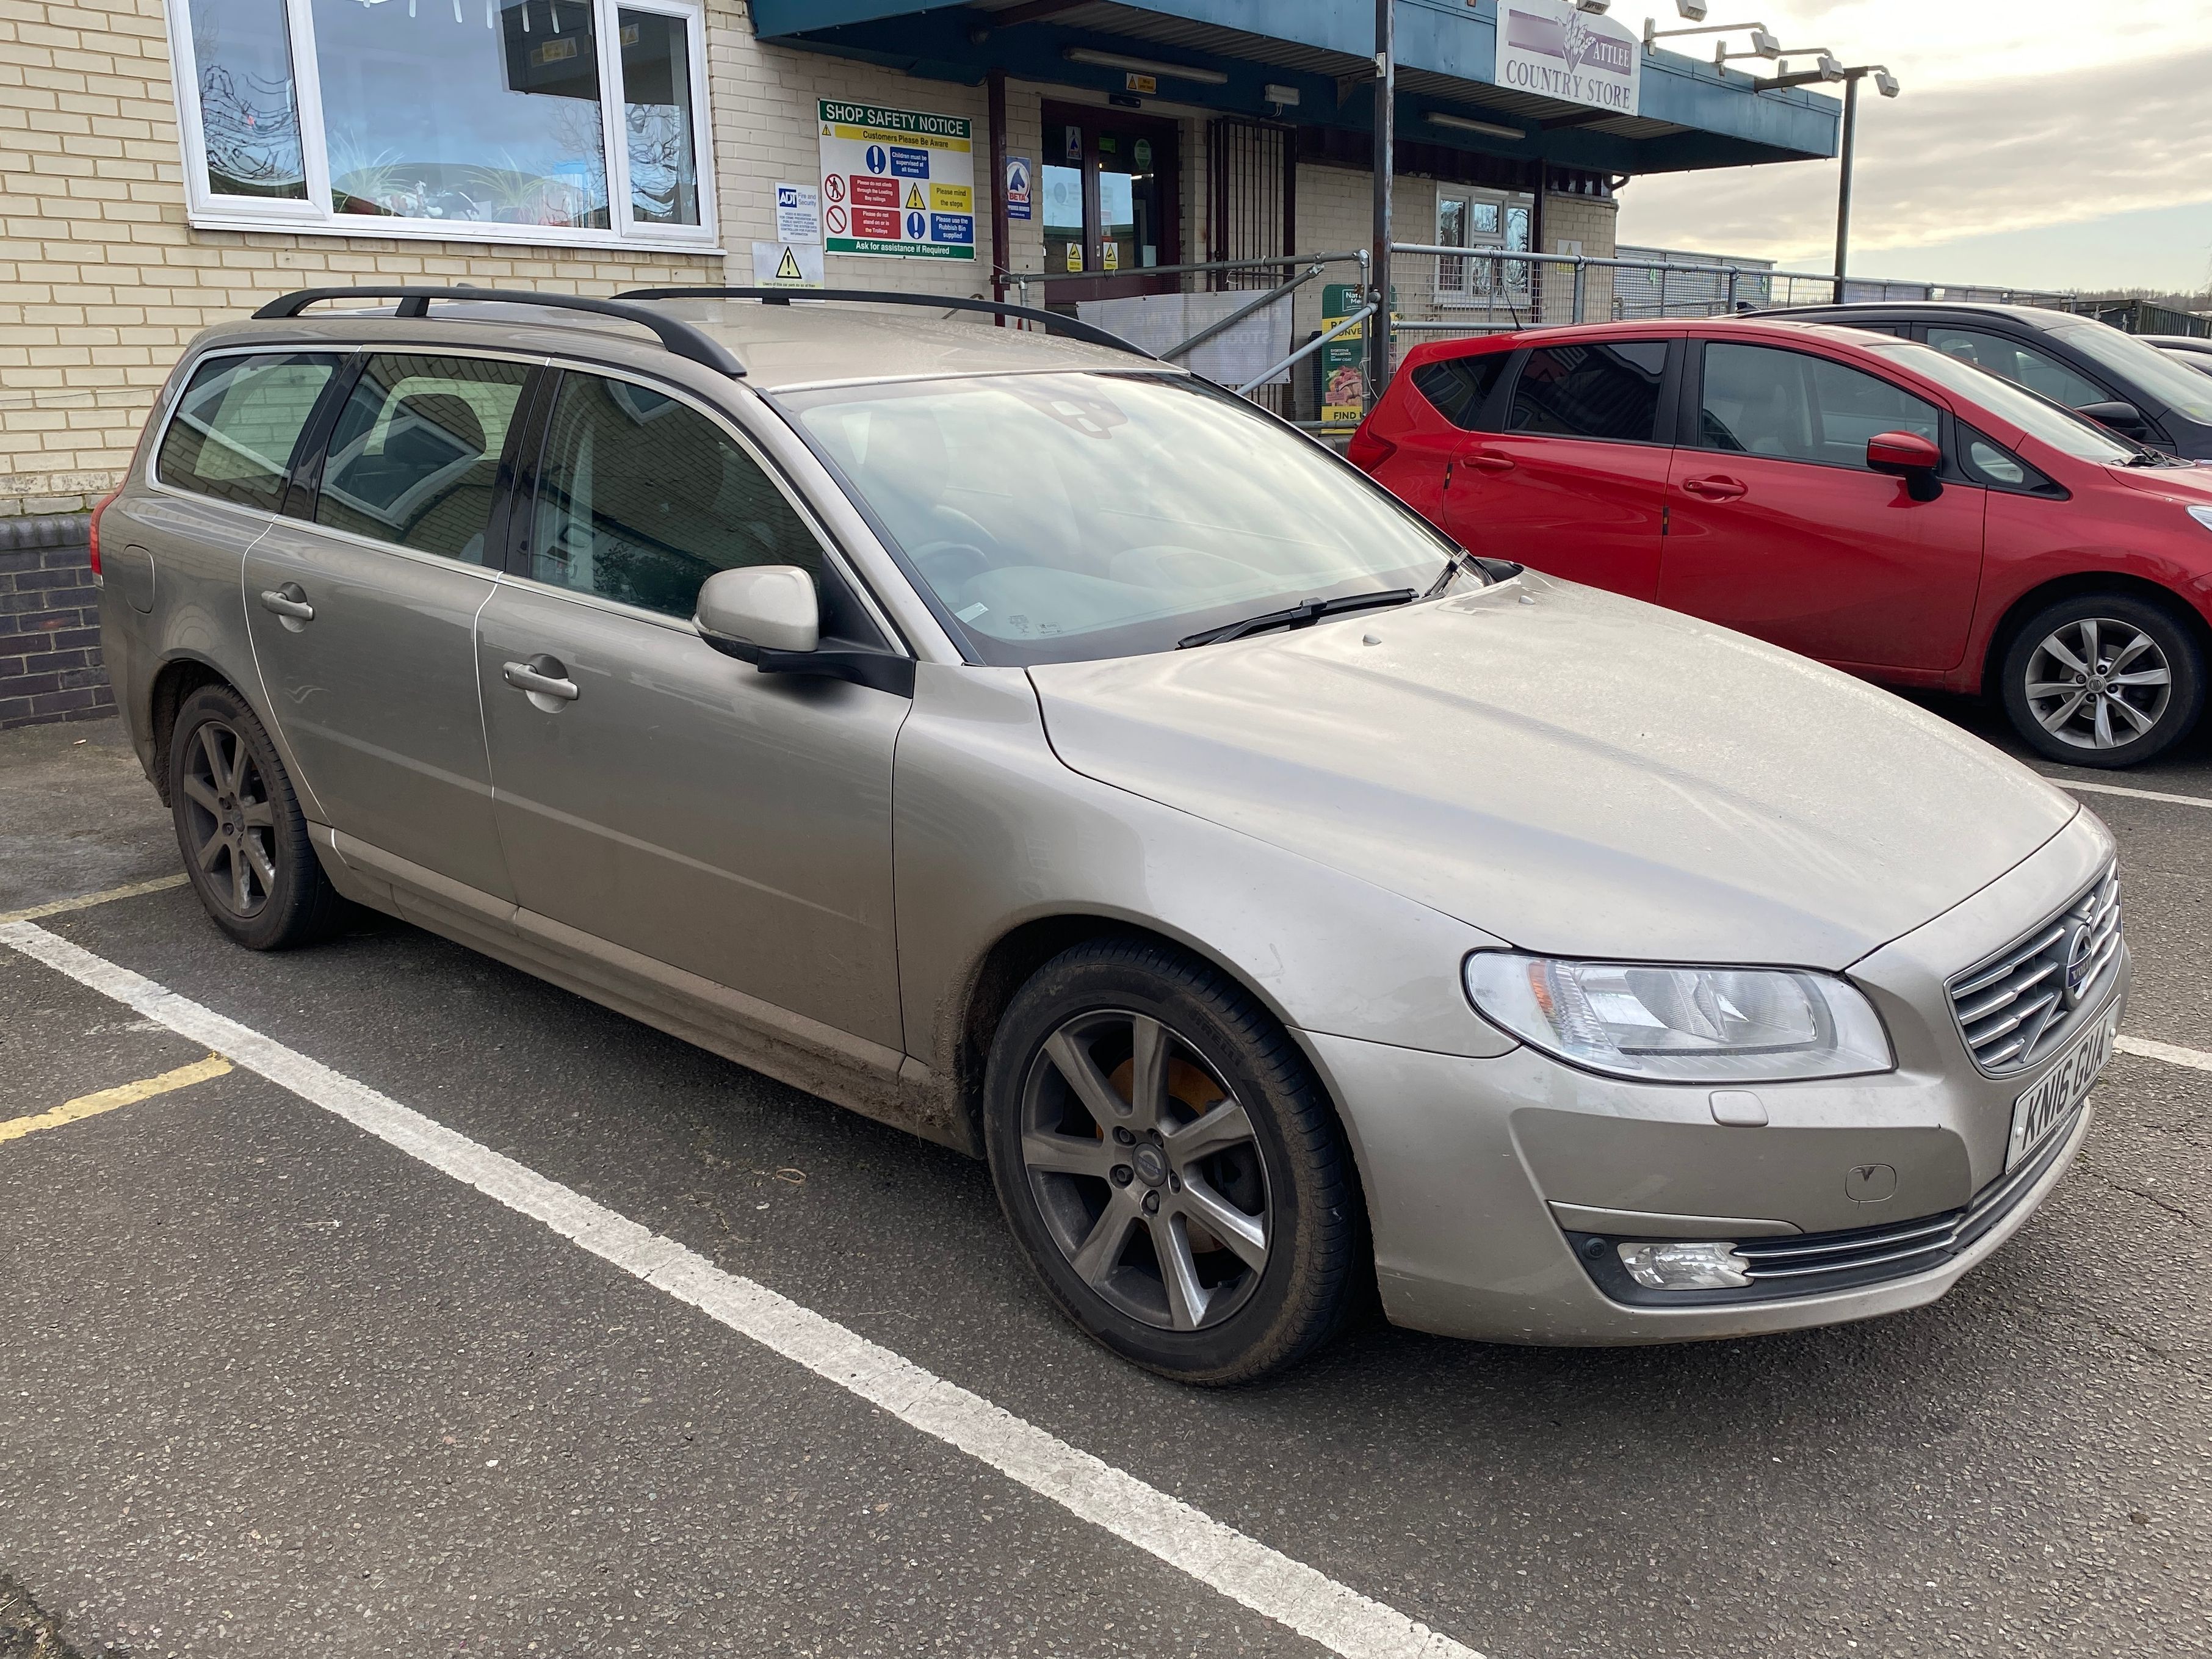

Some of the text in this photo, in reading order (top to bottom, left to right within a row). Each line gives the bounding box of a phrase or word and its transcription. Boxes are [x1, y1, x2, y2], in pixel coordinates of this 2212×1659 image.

[1593, 42, 1630, 68] ATTLEE
[1506, 60, 1630, 109] COUNTRY STORE
[826, 104, 963, 135] SHOP SAFETY NOTICE
[863, 131, 897, 142] Customers
[898, 135, 919, 145] Please
[930, 139, 948, 148] Aware
[779, 192, 796, 204] ADT
[856, 241, 869, 250] Ask
[870, 242, 880, 250] for
[922, 245, 949, 255] Required
[2072, 959, 2089, 980] VOLV
[2022, 1019, 2107, 1151] KN16 GUA
